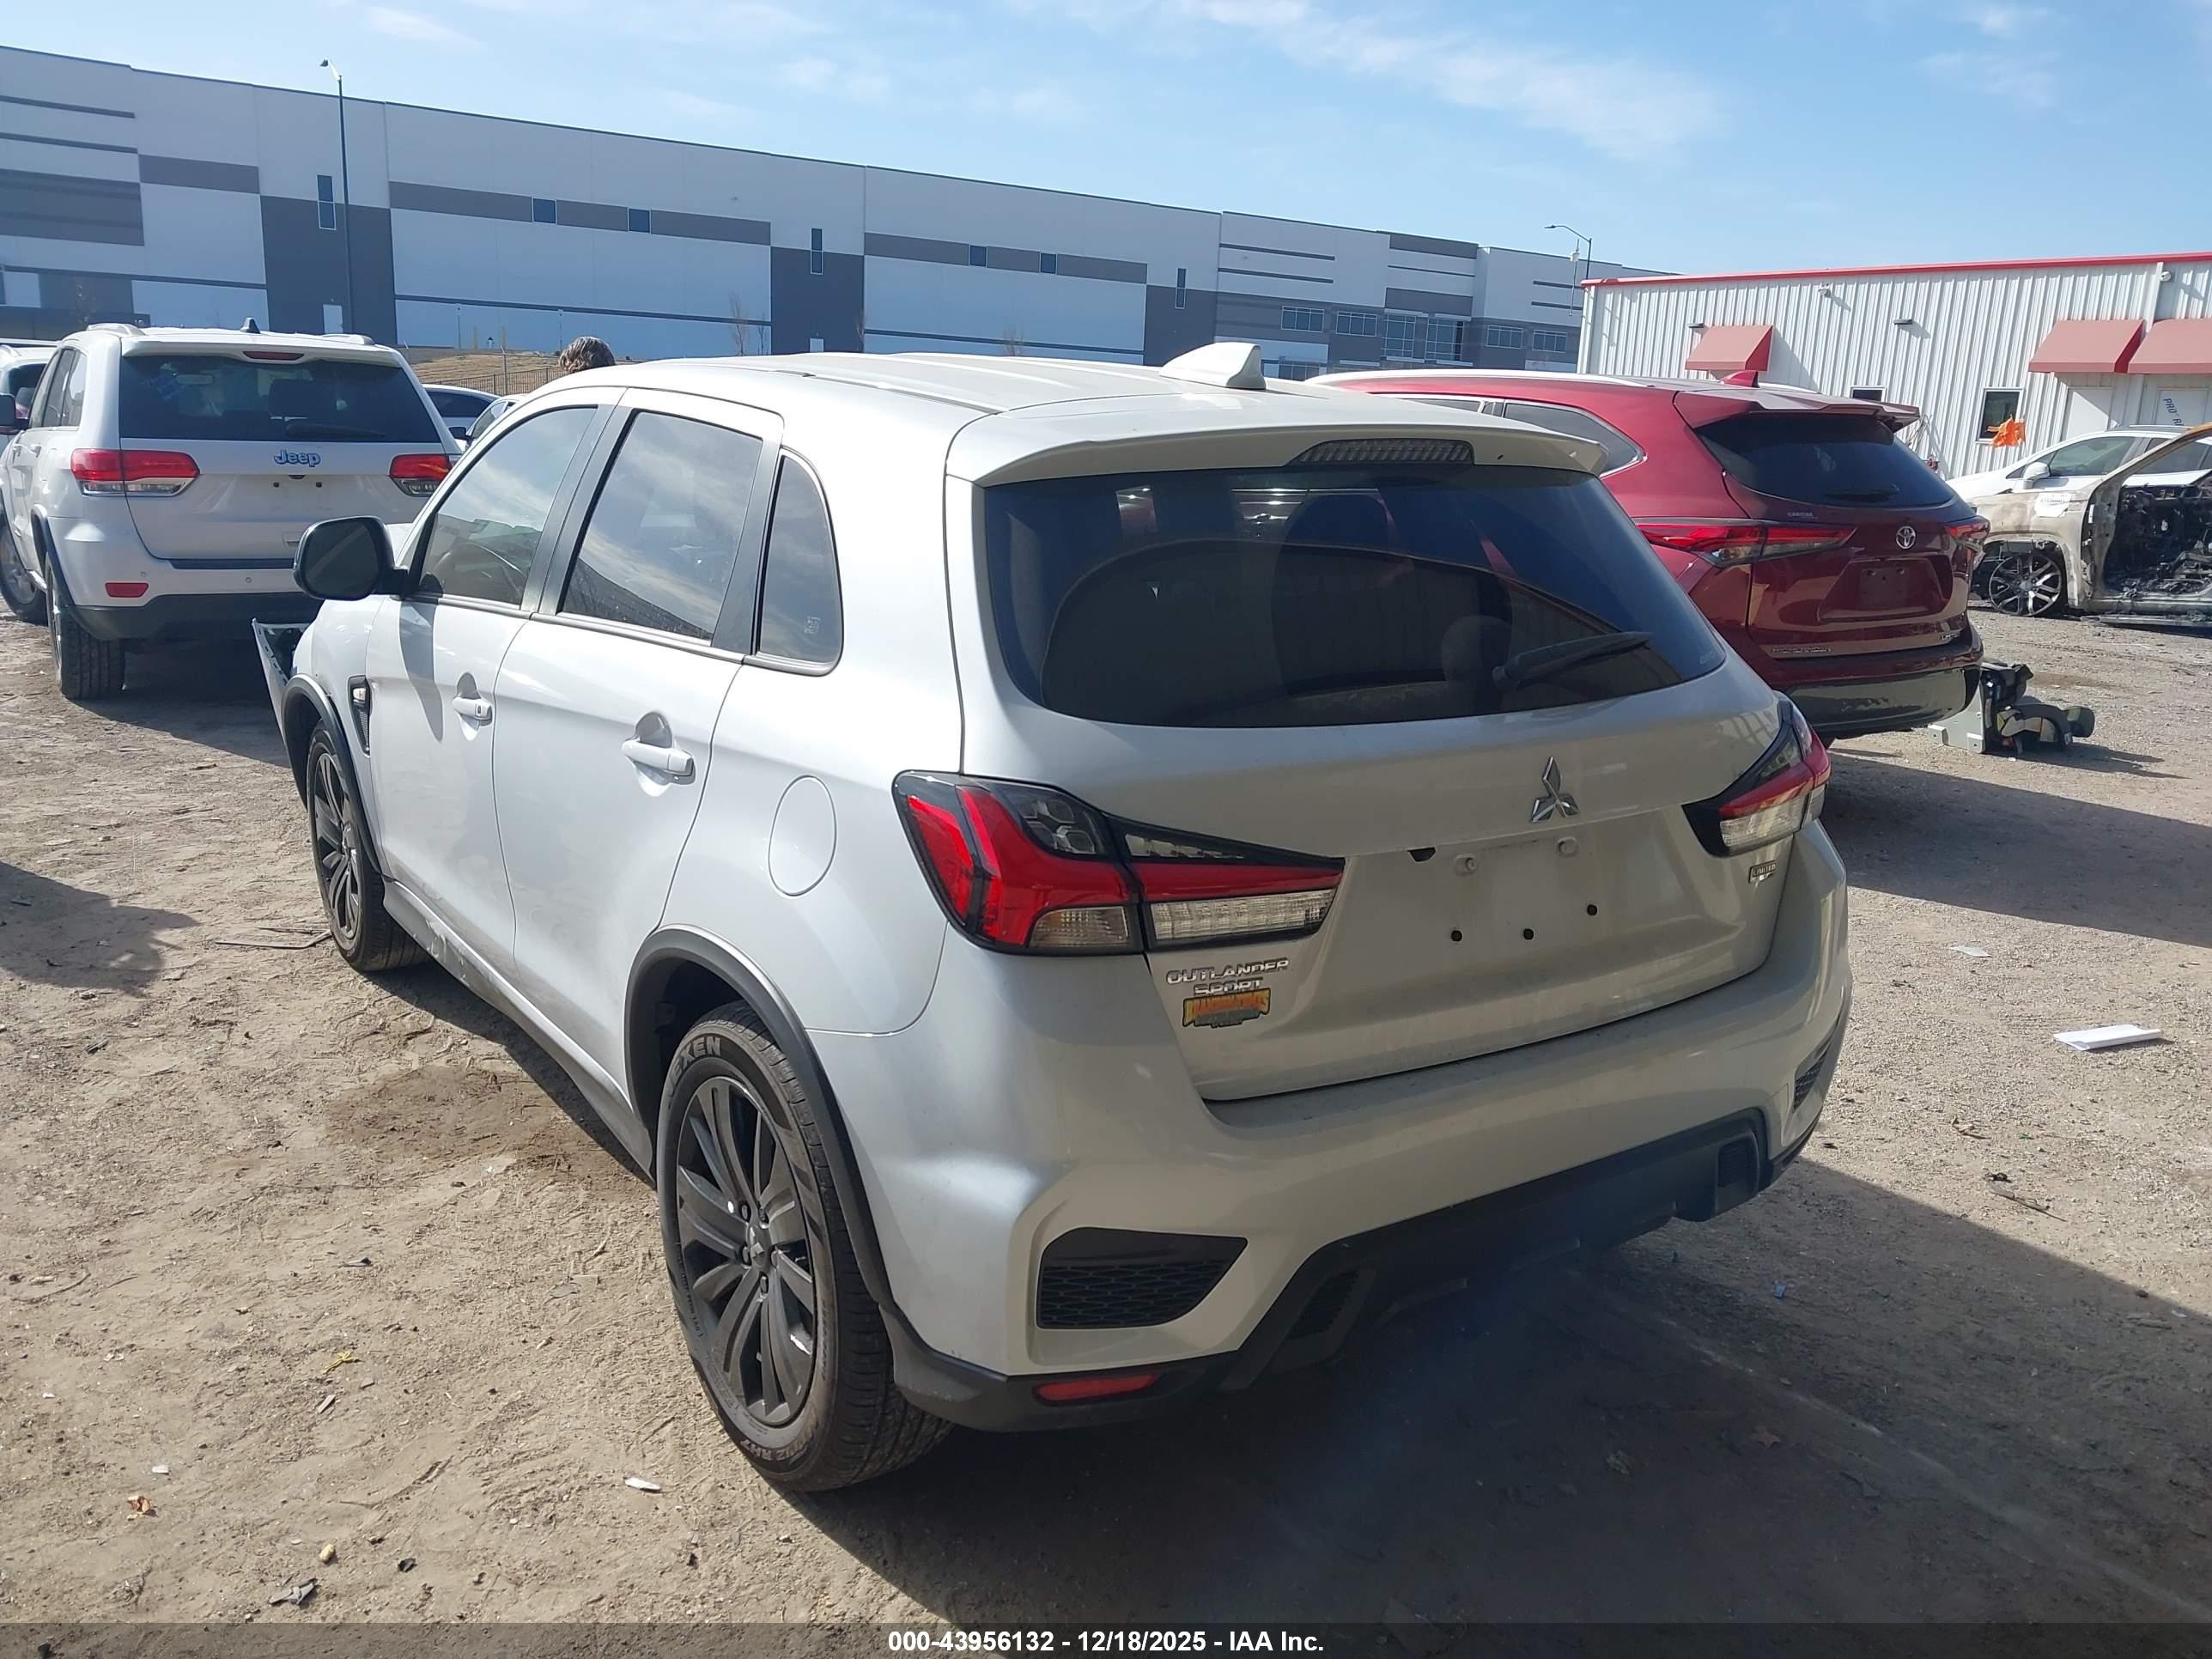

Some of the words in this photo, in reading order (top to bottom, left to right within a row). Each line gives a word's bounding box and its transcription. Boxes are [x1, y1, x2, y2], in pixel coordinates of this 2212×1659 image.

[274, 449, 321, 468] Jeep
[1166, 957, 1290, 985] OUTLANDER
[1194, 977, 1263, 996] SPORT
